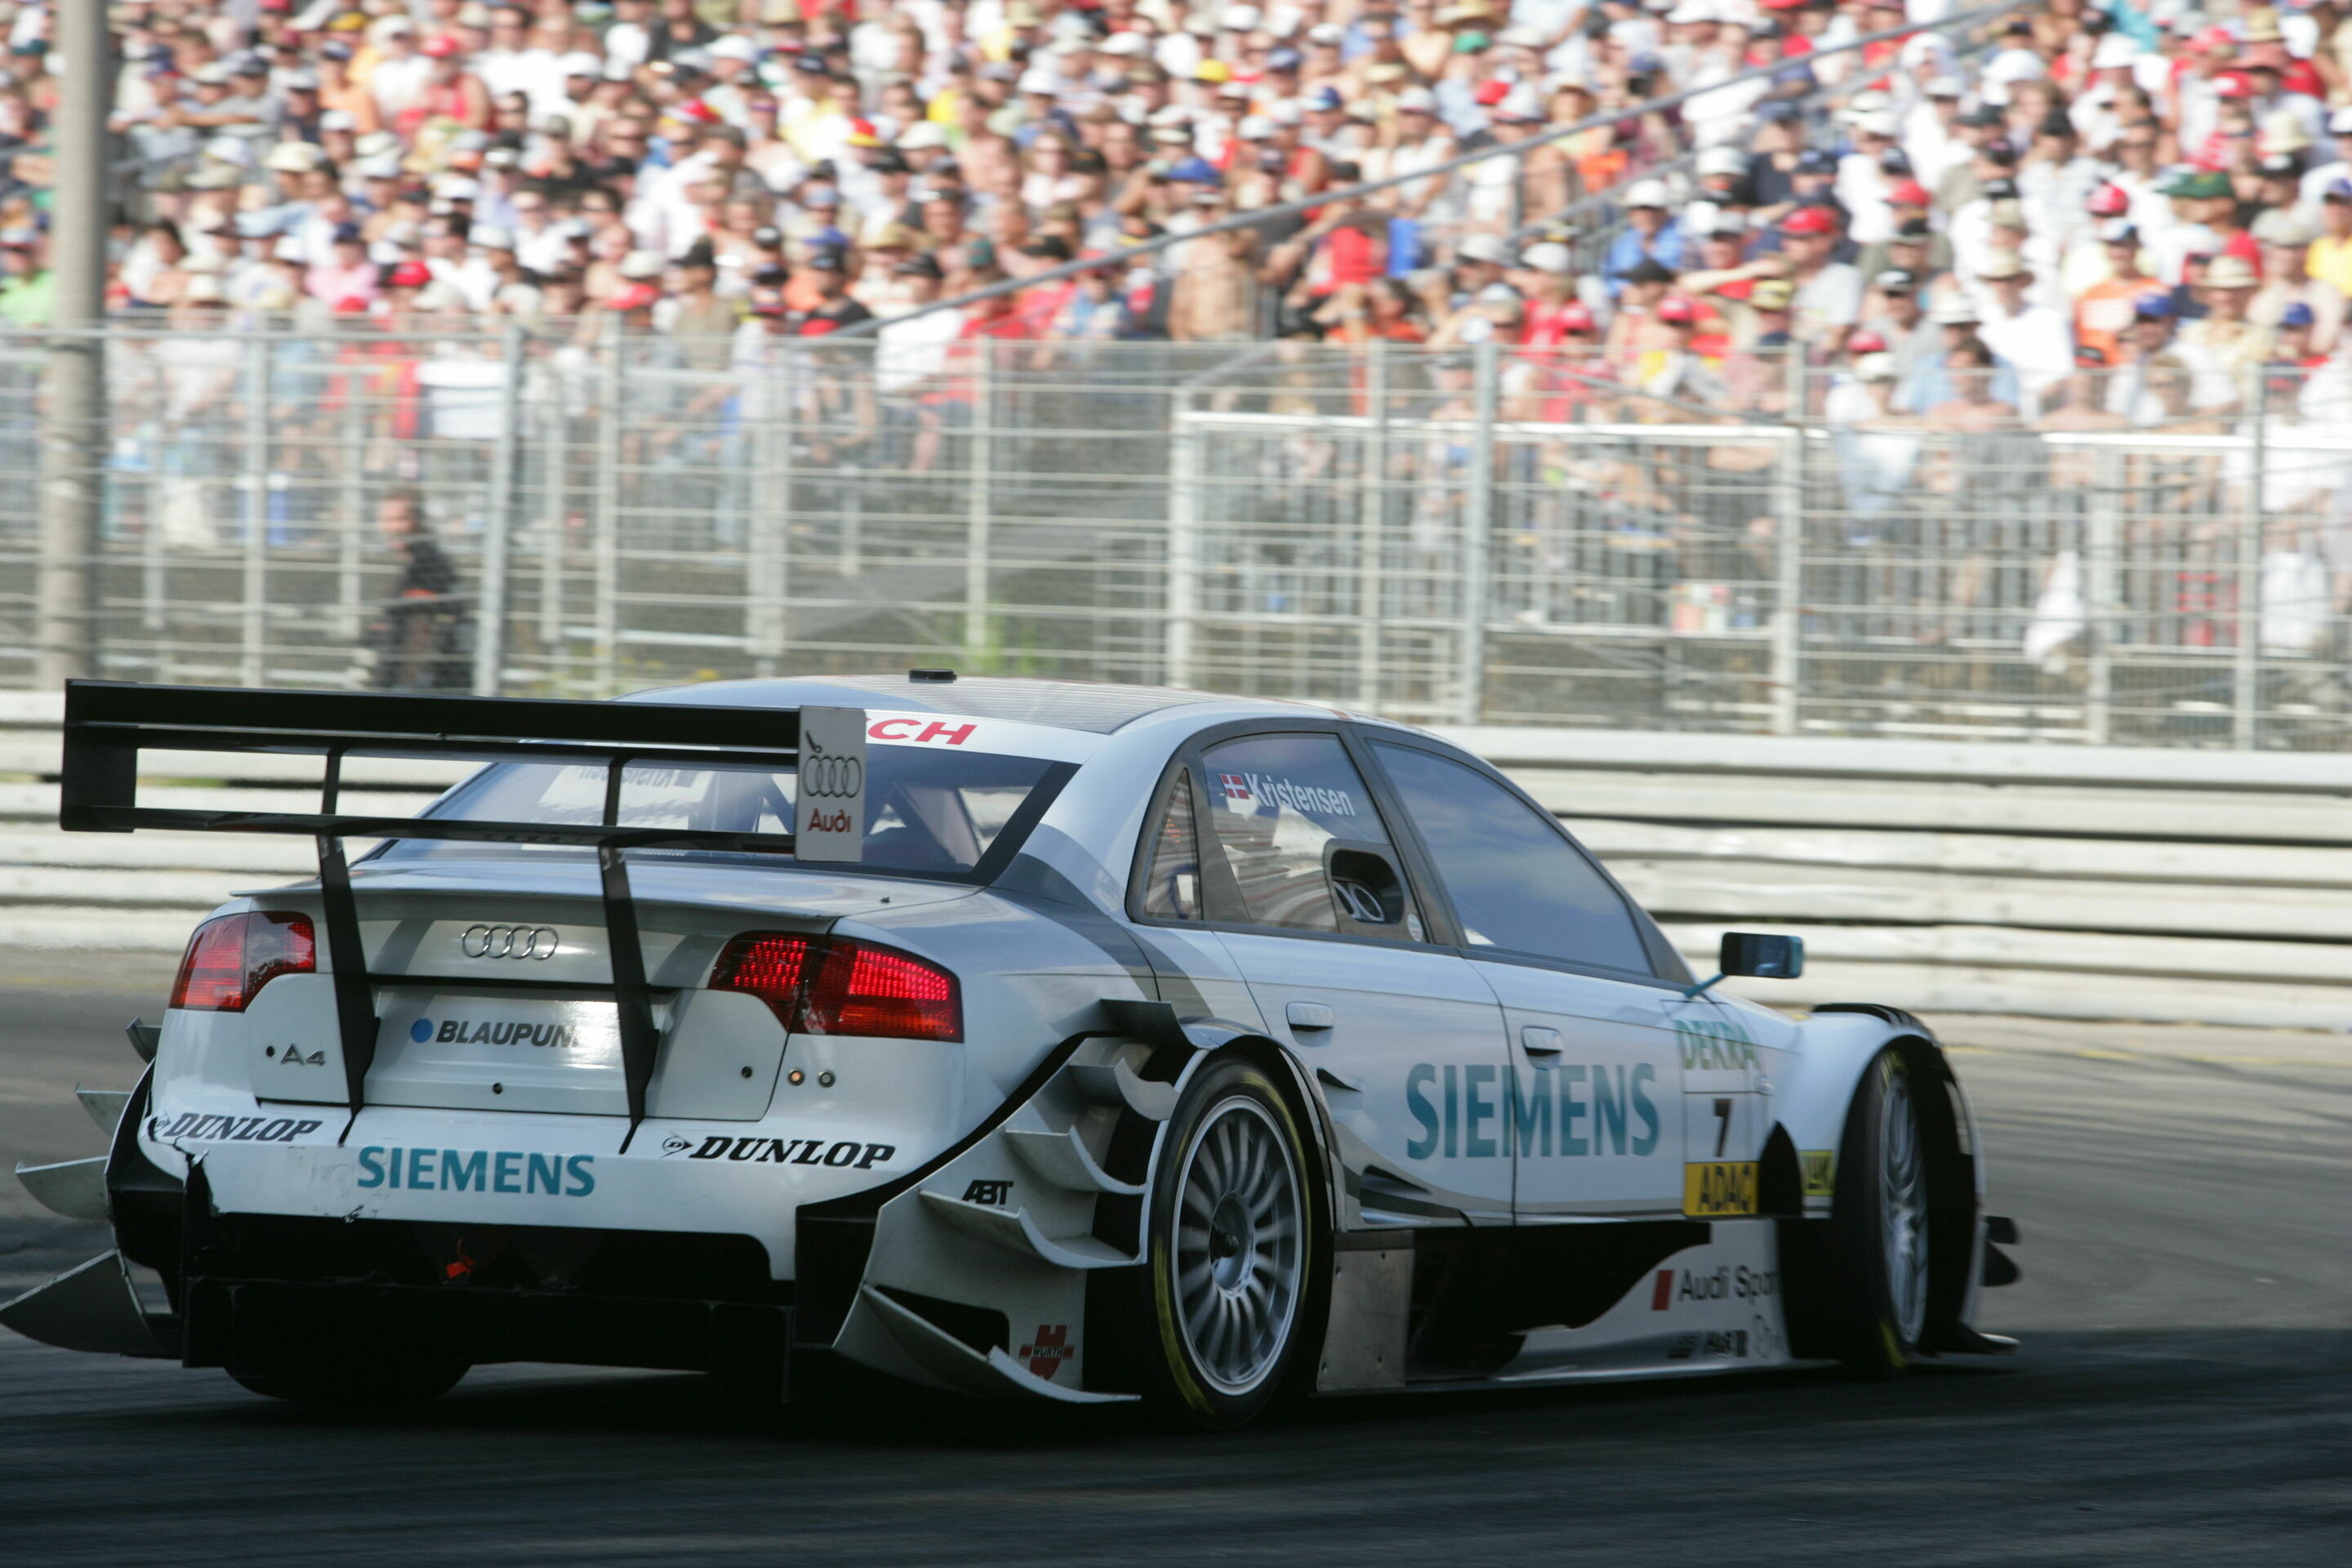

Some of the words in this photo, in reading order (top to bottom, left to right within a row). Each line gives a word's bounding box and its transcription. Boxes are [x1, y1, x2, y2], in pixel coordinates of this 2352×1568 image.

[866, 719, 978, 745] CH
[1244, 773, 1356, 816] Kristensen
[807, 808, 851, 833] Audi
[436, 1021, 579, 1048] BLAUPUN
[1674, 1020, 1762, 1070] DEKRA
[281, 1044, 326, 1066] A4
[163, 1112, 323, 1142] DUNLOP
[1406, 1063, 1659, 1160] SIEMENS
[1712, 1098, 1735, 1157] 7
[688, 1136, 896, 1169] DUNLOP
[357, 1146, 595, 1197] SIEMENS
[1698, 1163, 1752, 1213] ADAC
[961, 1179, 1014, 1205] ABT
[1677, 1266, 1730, 1302] Audi
[1734, 1265, 1781, 1305] Spor
